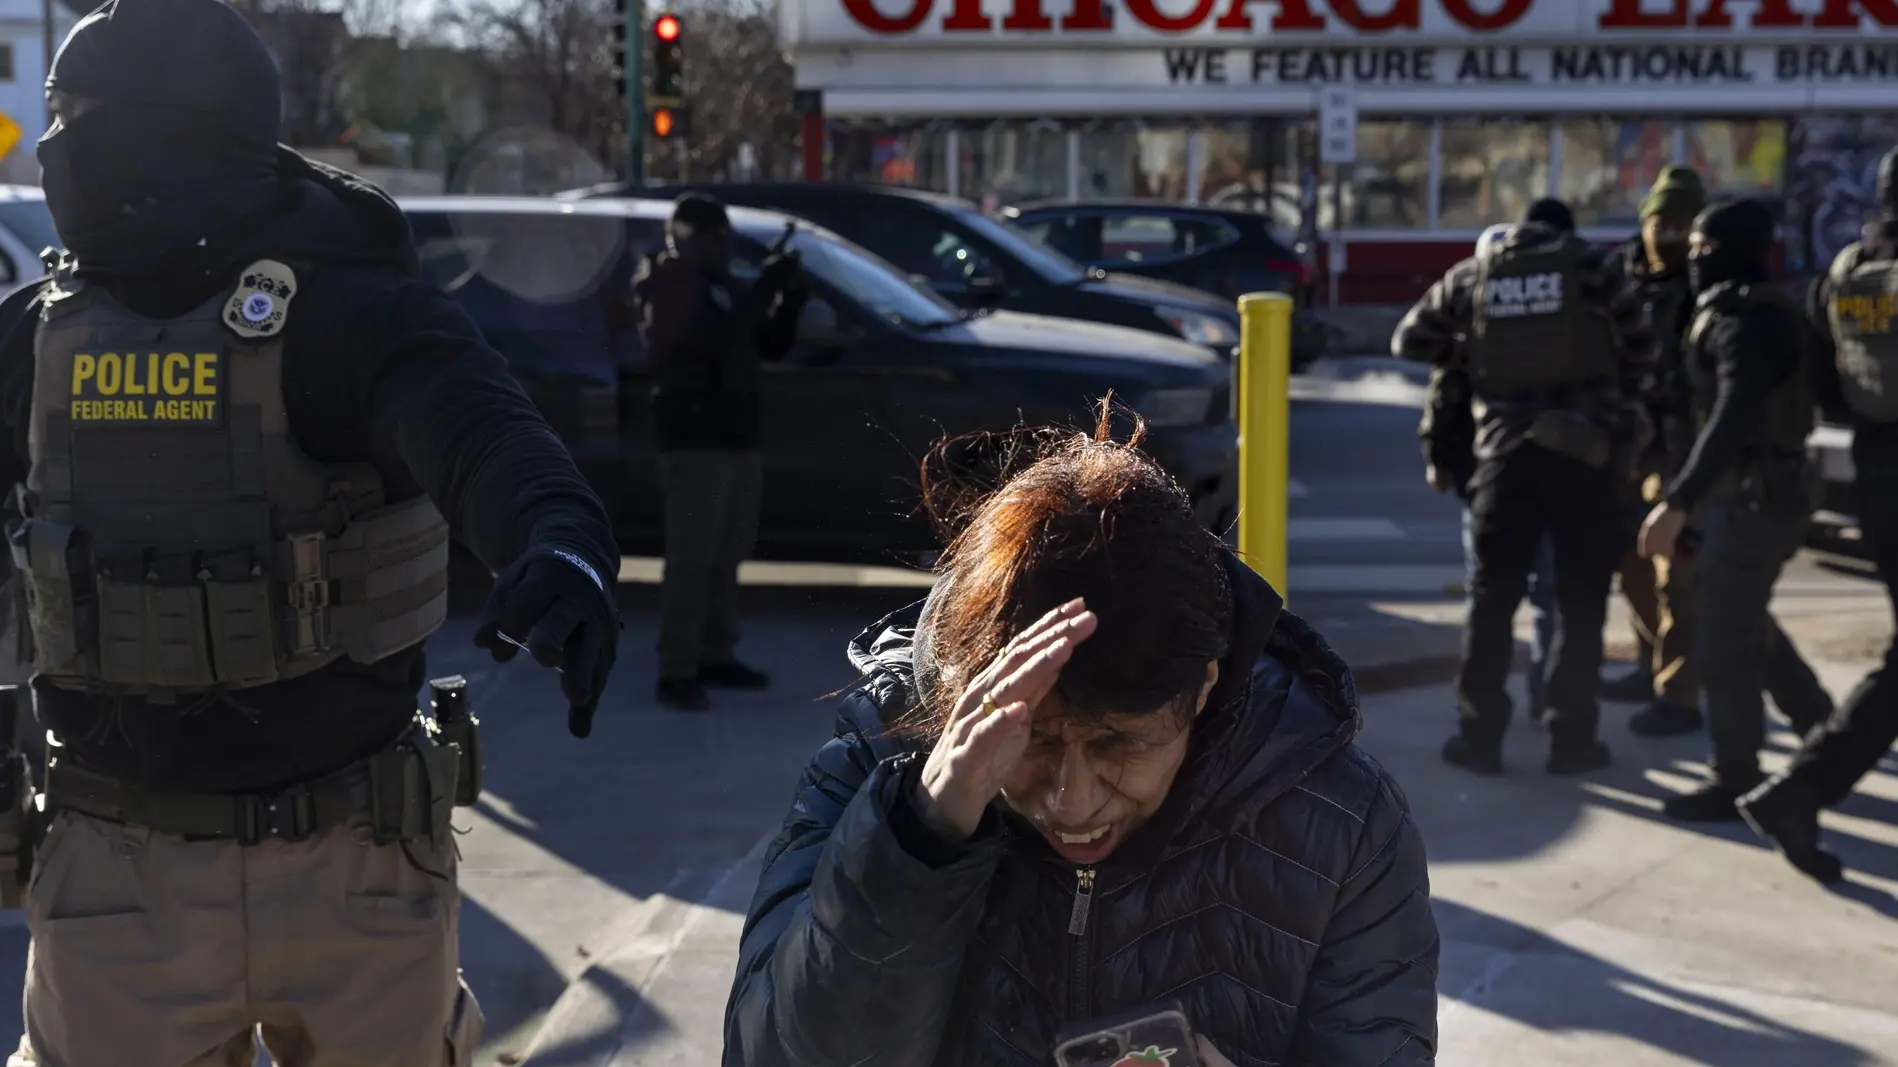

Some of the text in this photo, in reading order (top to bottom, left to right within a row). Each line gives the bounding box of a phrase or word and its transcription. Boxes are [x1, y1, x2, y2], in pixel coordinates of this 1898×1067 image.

[1164, 45, 1898, 83] WE FEATURE ALL NATIONAL BRAN
[1484, 271, 1563, 304] POLICE
[72, 352, 217, 396] POLICE
[71, 399, 216, 420] FEDERAL AGENT
